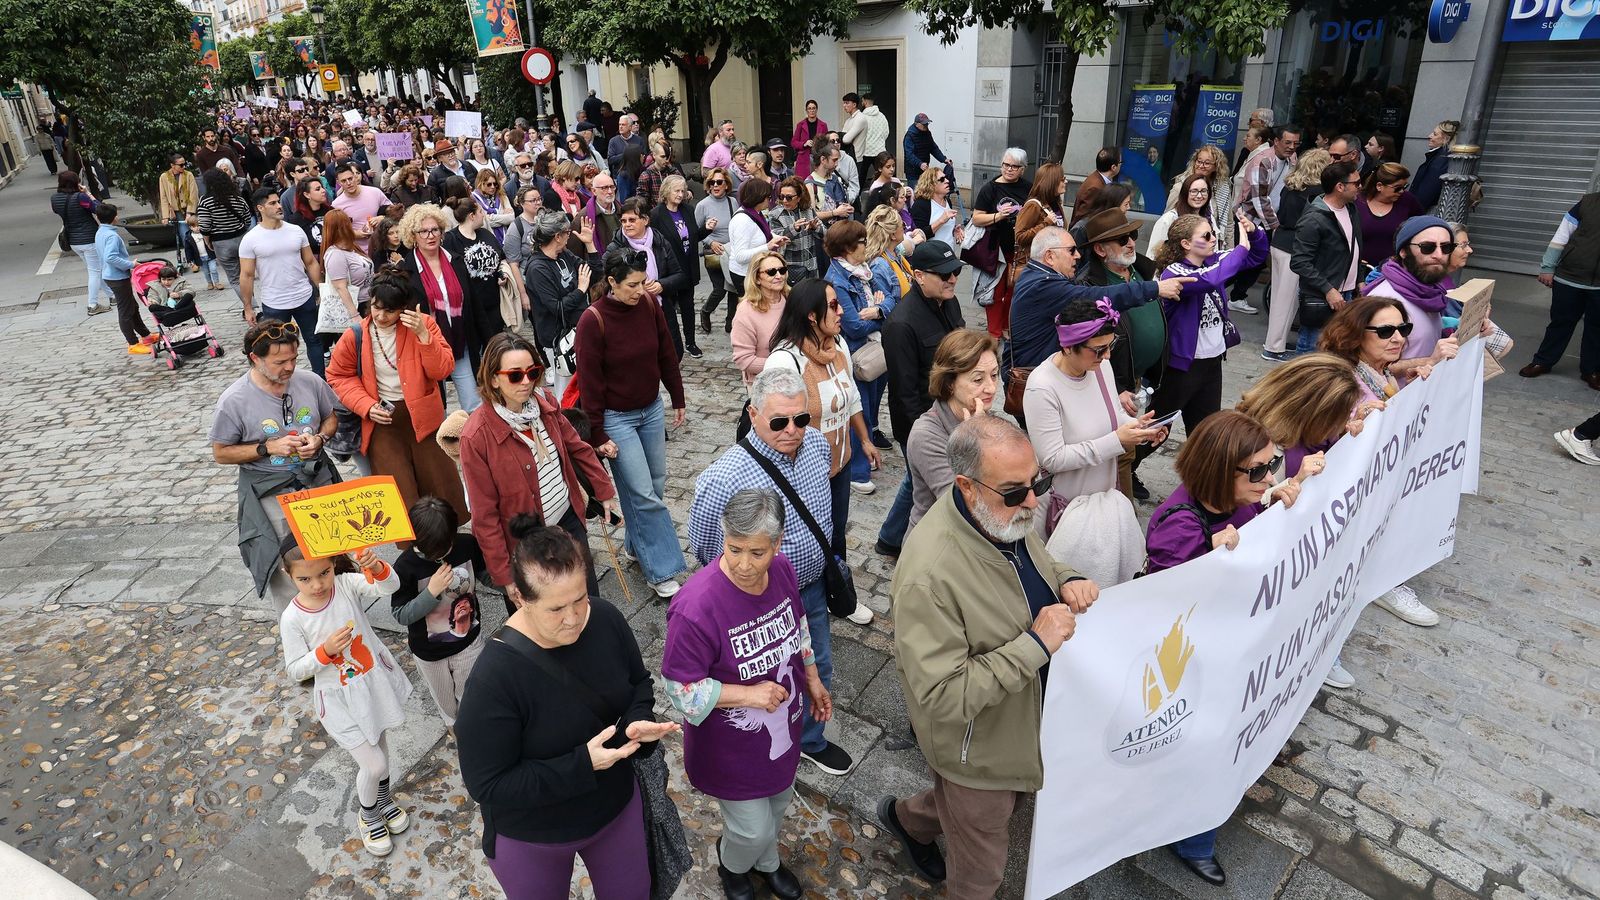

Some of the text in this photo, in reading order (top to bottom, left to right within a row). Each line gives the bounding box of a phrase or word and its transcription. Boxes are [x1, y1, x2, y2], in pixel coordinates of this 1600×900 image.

[1444, 3, 1462, 17] DIGI
[1511, 0, 1600, 19] DIG
[198, 16, 211, 26] 30
[1320, 19, 1384, 42] DIGI
[1214, 93, 1235, 101] DIGI
[1207, 109, 1237, 118] 500Mb
[1439, 534, 1455, 547] ESPA
[1241, 655, 1272, 713] NI
[1275, 617, 1309, 680] UN
[1307, 562, 1354, 645] PASO
[1401, 440, 1466, 500] DEREC
[1250, 559, 1286, 618] NI
[1291, 525, 1319, 590] UN
[1120, 698, 1188, 746] ATENEO
[1233, 661, 1308, 765] TODAS
[1127, 728, 1183, 758] DE JEREZ
